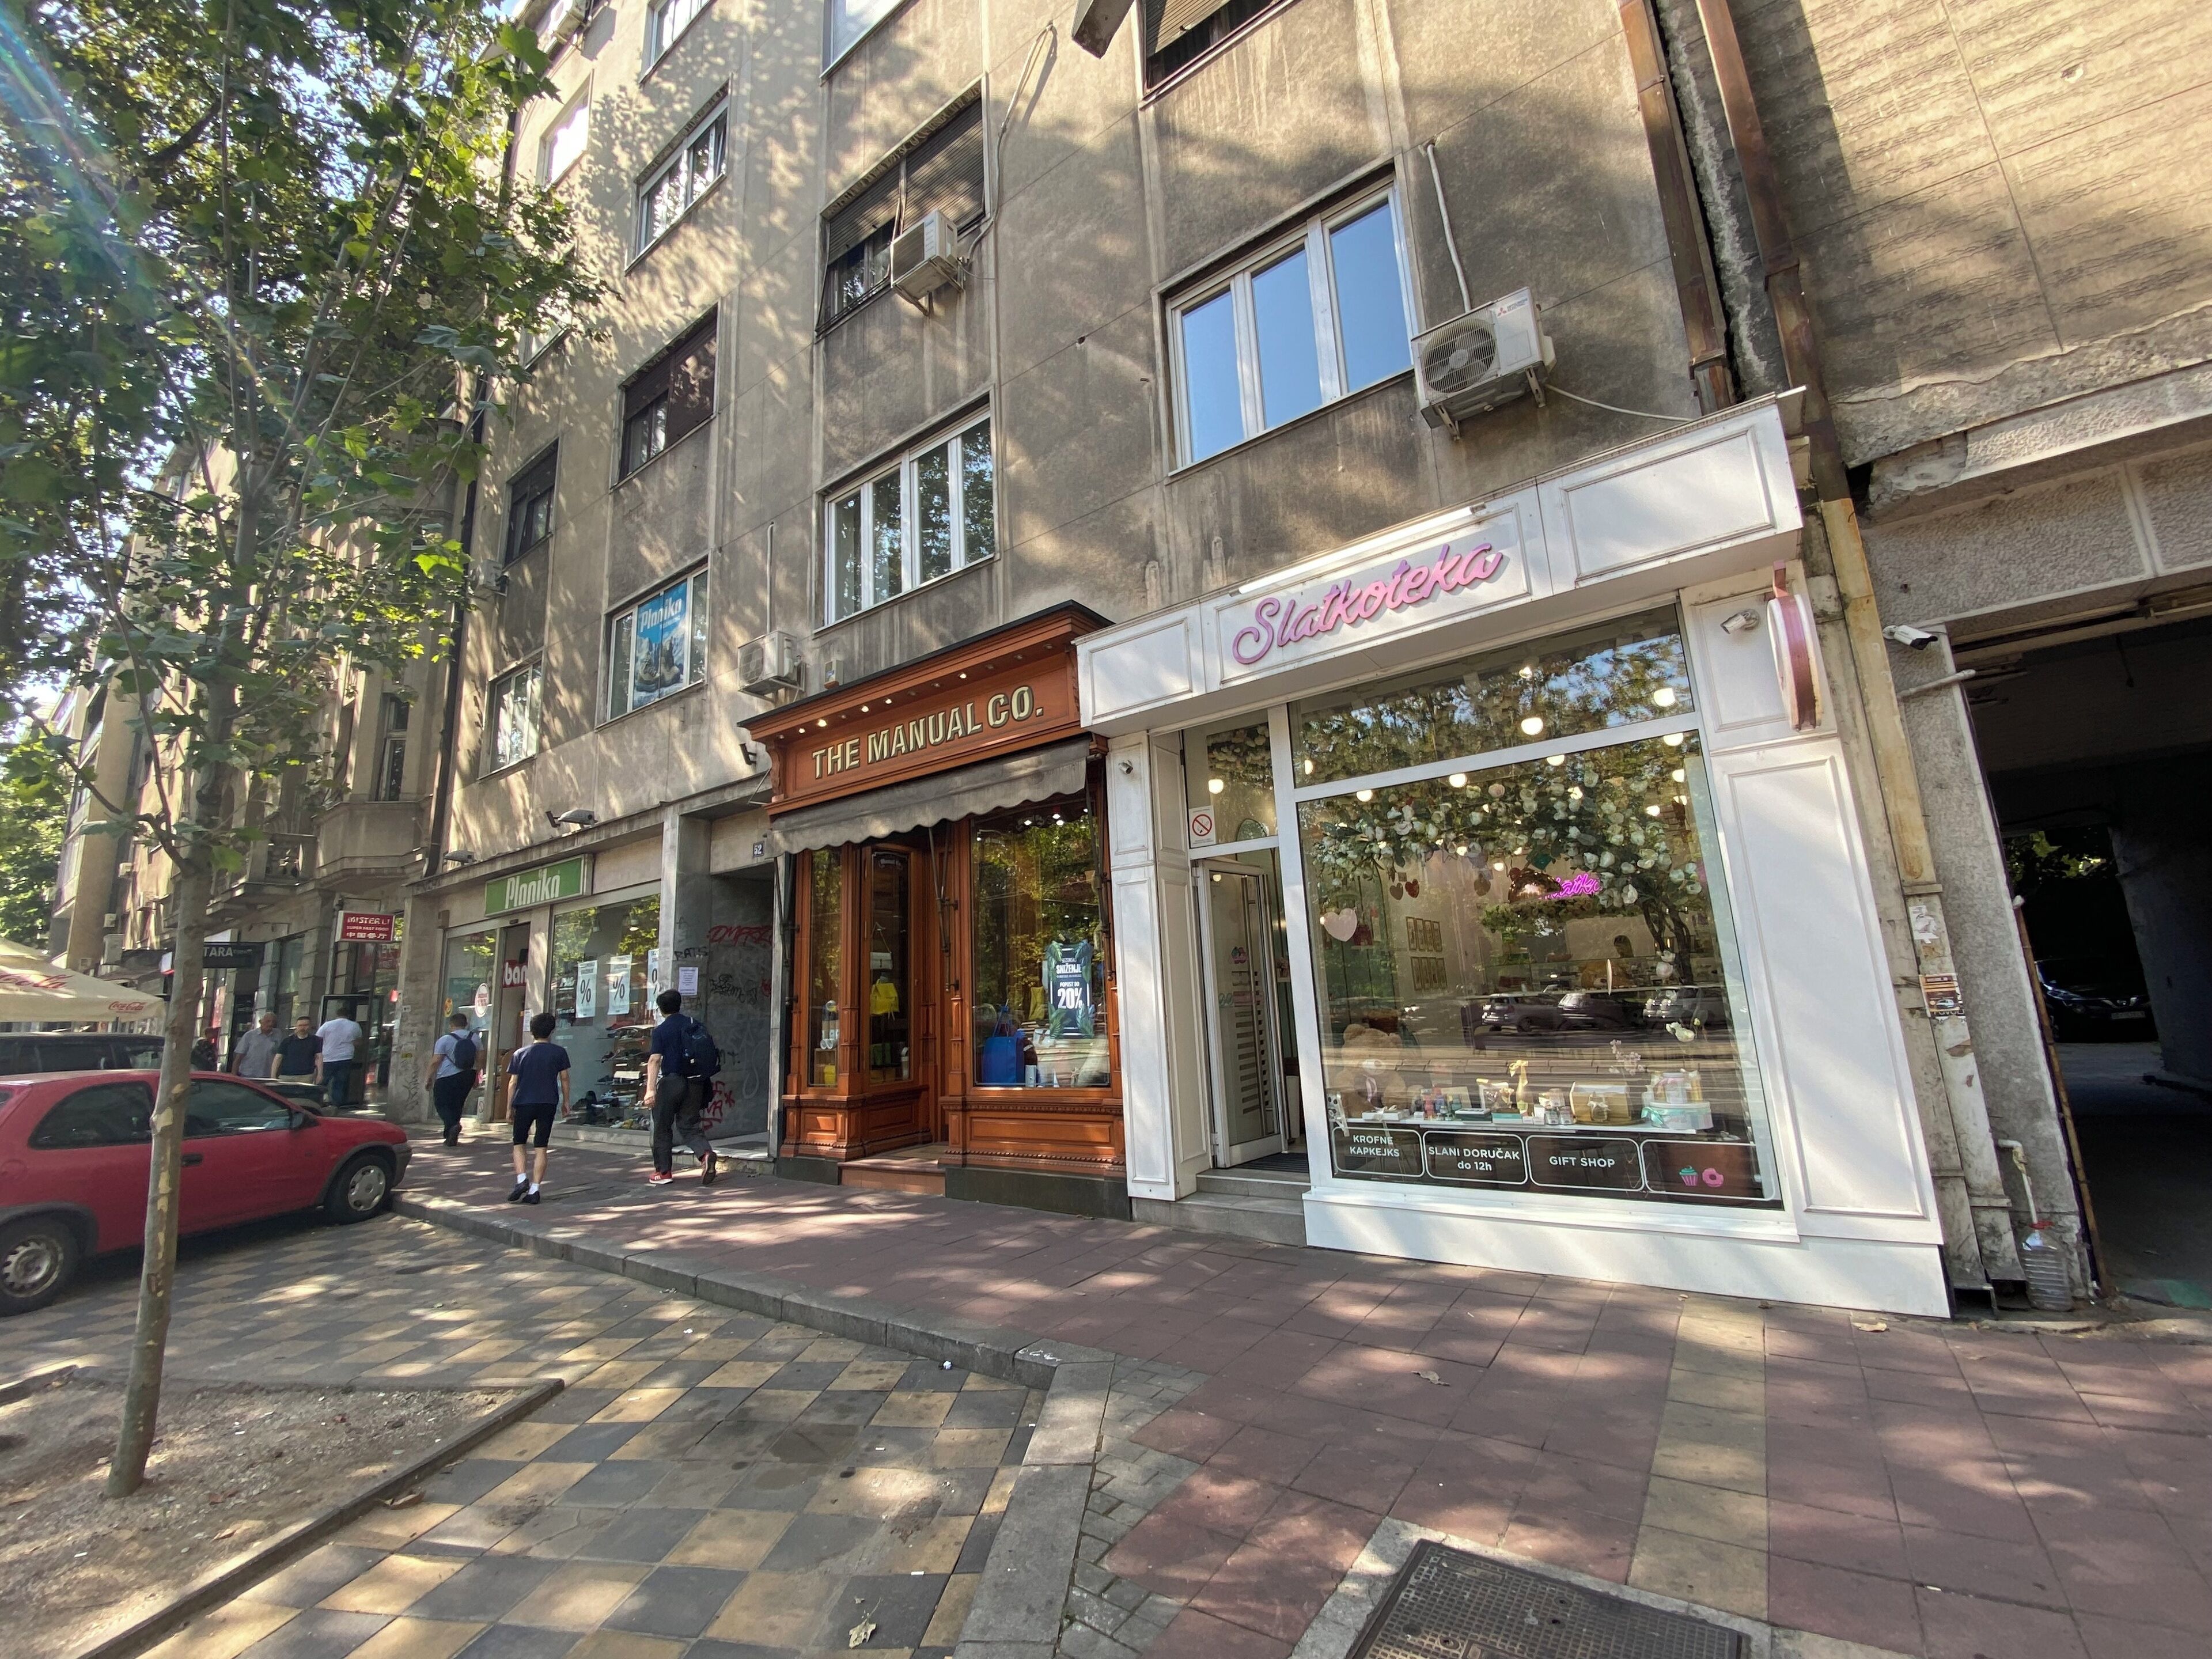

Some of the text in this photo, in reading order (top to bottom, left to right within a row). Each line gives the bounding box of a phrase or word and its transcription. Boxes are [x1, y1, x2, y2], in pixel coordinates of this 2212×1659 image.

[1232, 543, 1503, 665] Slatkoteka
[640, 597, 682, 632] Planika
[812, 685, 1043, 779] THE MANUAL CO.
[754, 844, 762, 855] 52
[505, 868, 560, 909] Planika
[1056, 963, 1082, 974] SNIŽENJE
[1057, 988, 1083, 1009] 20%
[1353, 1135, 1393, 1145] KROFNE
[1350, 1146, 1400, 1157] KAPKEJKS
[1429, 1146, 1520, 1160] SLANI DORUČAK
[1457, 1161, 1492, 1171] do 12h
[1549, 1156, 1615, 1168] GIFT SHOP
